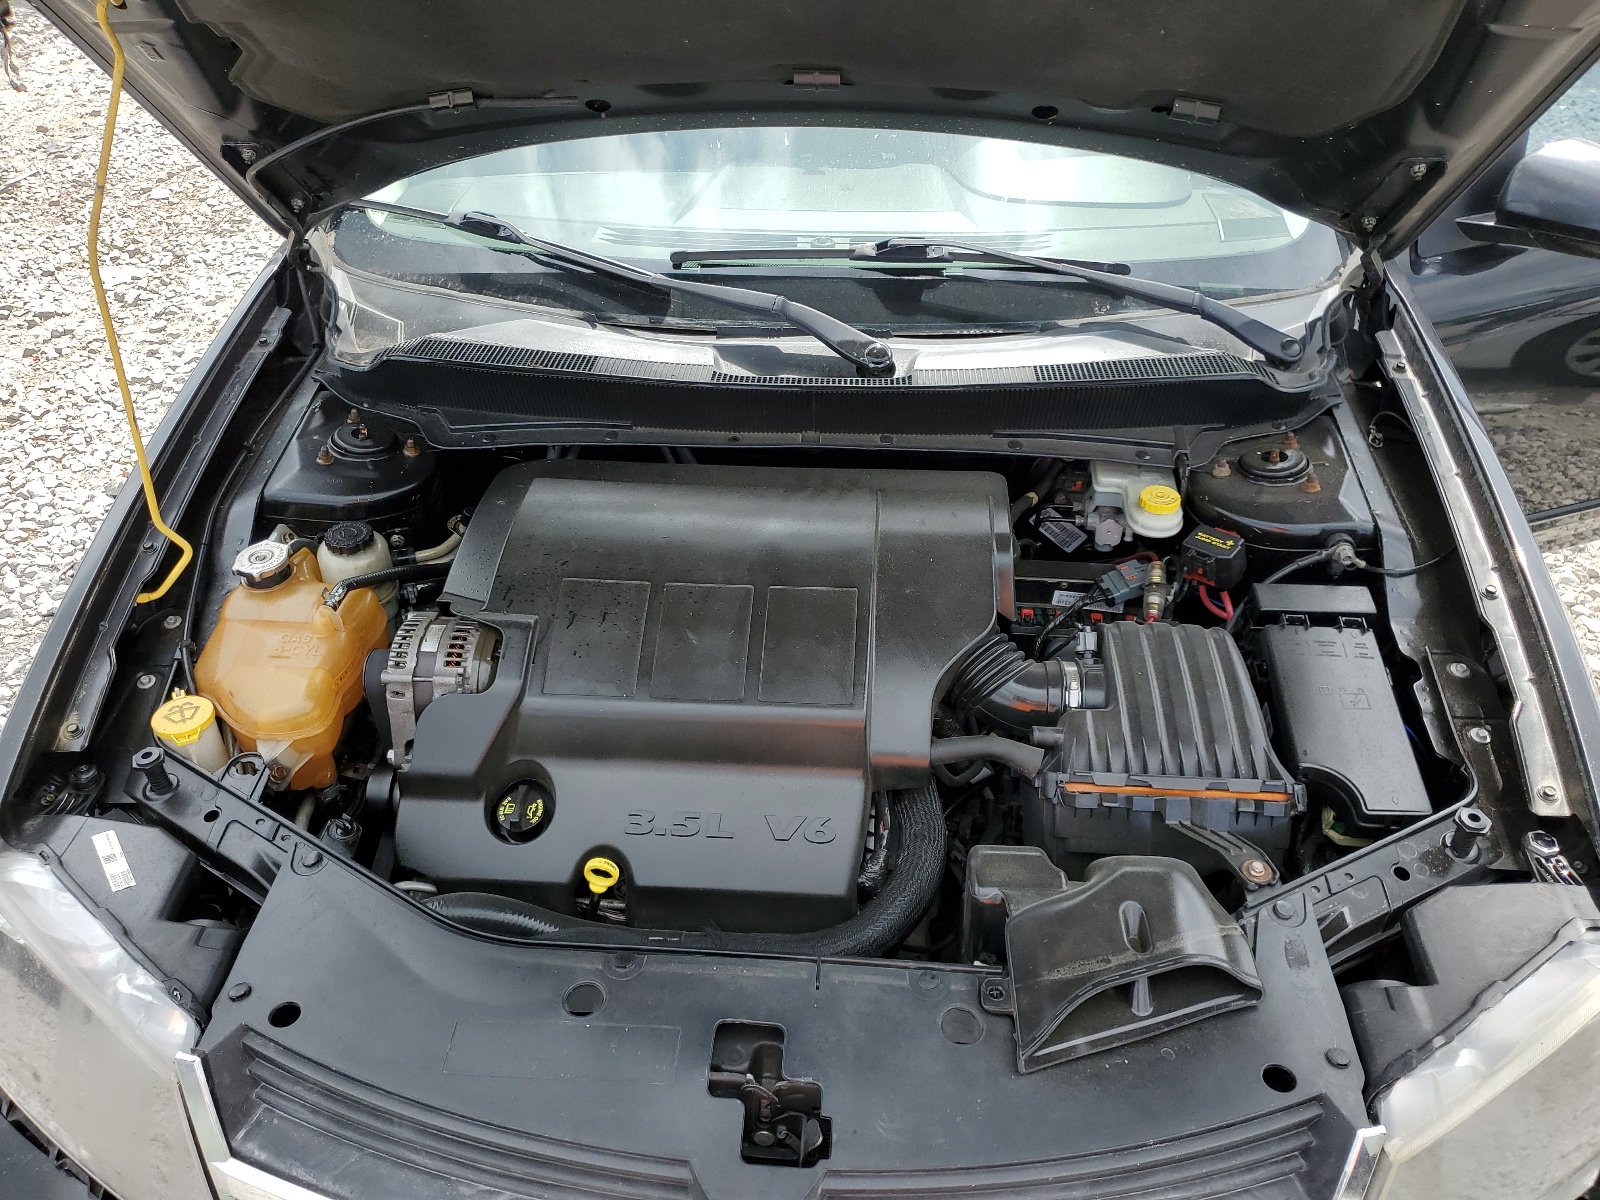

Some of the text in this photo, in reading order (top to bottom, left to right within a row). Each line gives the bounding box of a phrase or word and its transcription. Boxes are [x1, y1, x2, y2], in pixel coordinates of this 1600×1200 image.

[1197, 532, 1224, 543] BATTERY
[279, 634, 312, 643] GAS
[624, 809, 837, 844] 3.5L V6
